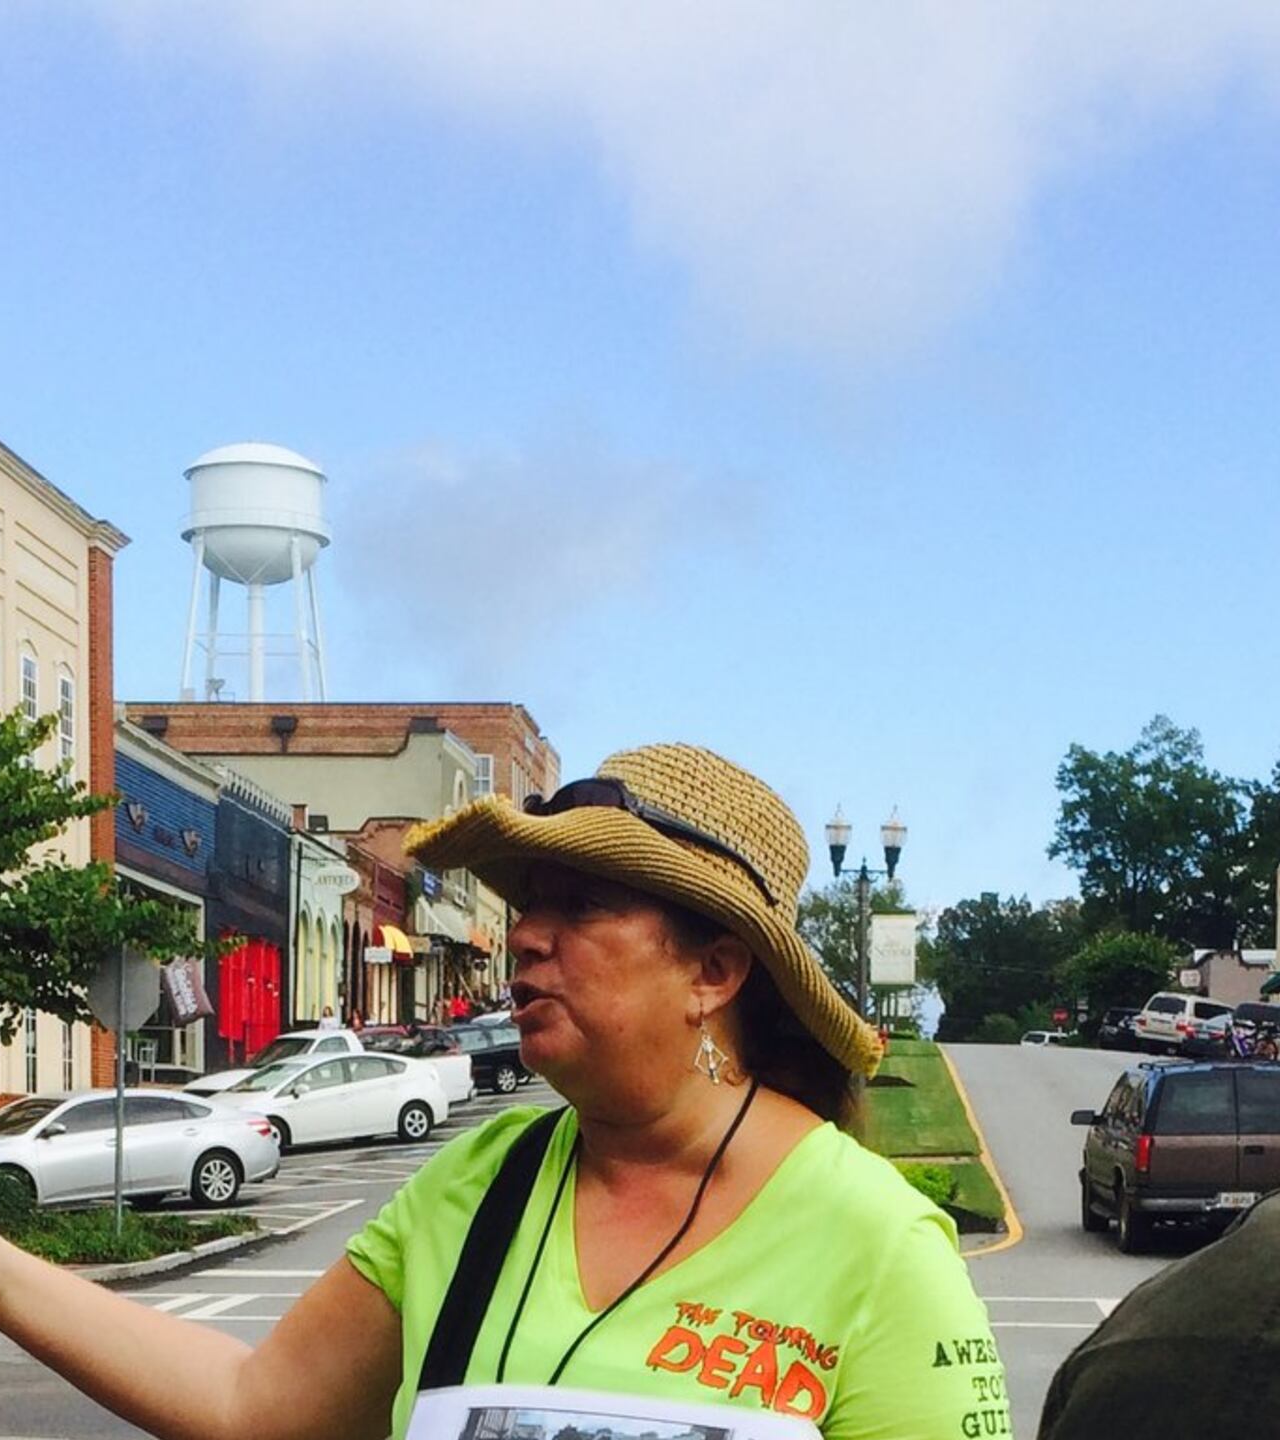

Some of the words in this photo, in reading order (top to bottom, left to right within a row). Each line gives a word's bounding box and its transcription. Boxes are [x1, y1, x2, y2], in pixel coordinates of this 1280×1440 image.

[675, 1301, 723, 1327] THE
[731, 1310, 839, 1371] TOURING
[646, 1325, 827, 1420] DEAD
[972, 1374, 1004, 1402] TO
[961, 1409, 1008, 1439] GUI
